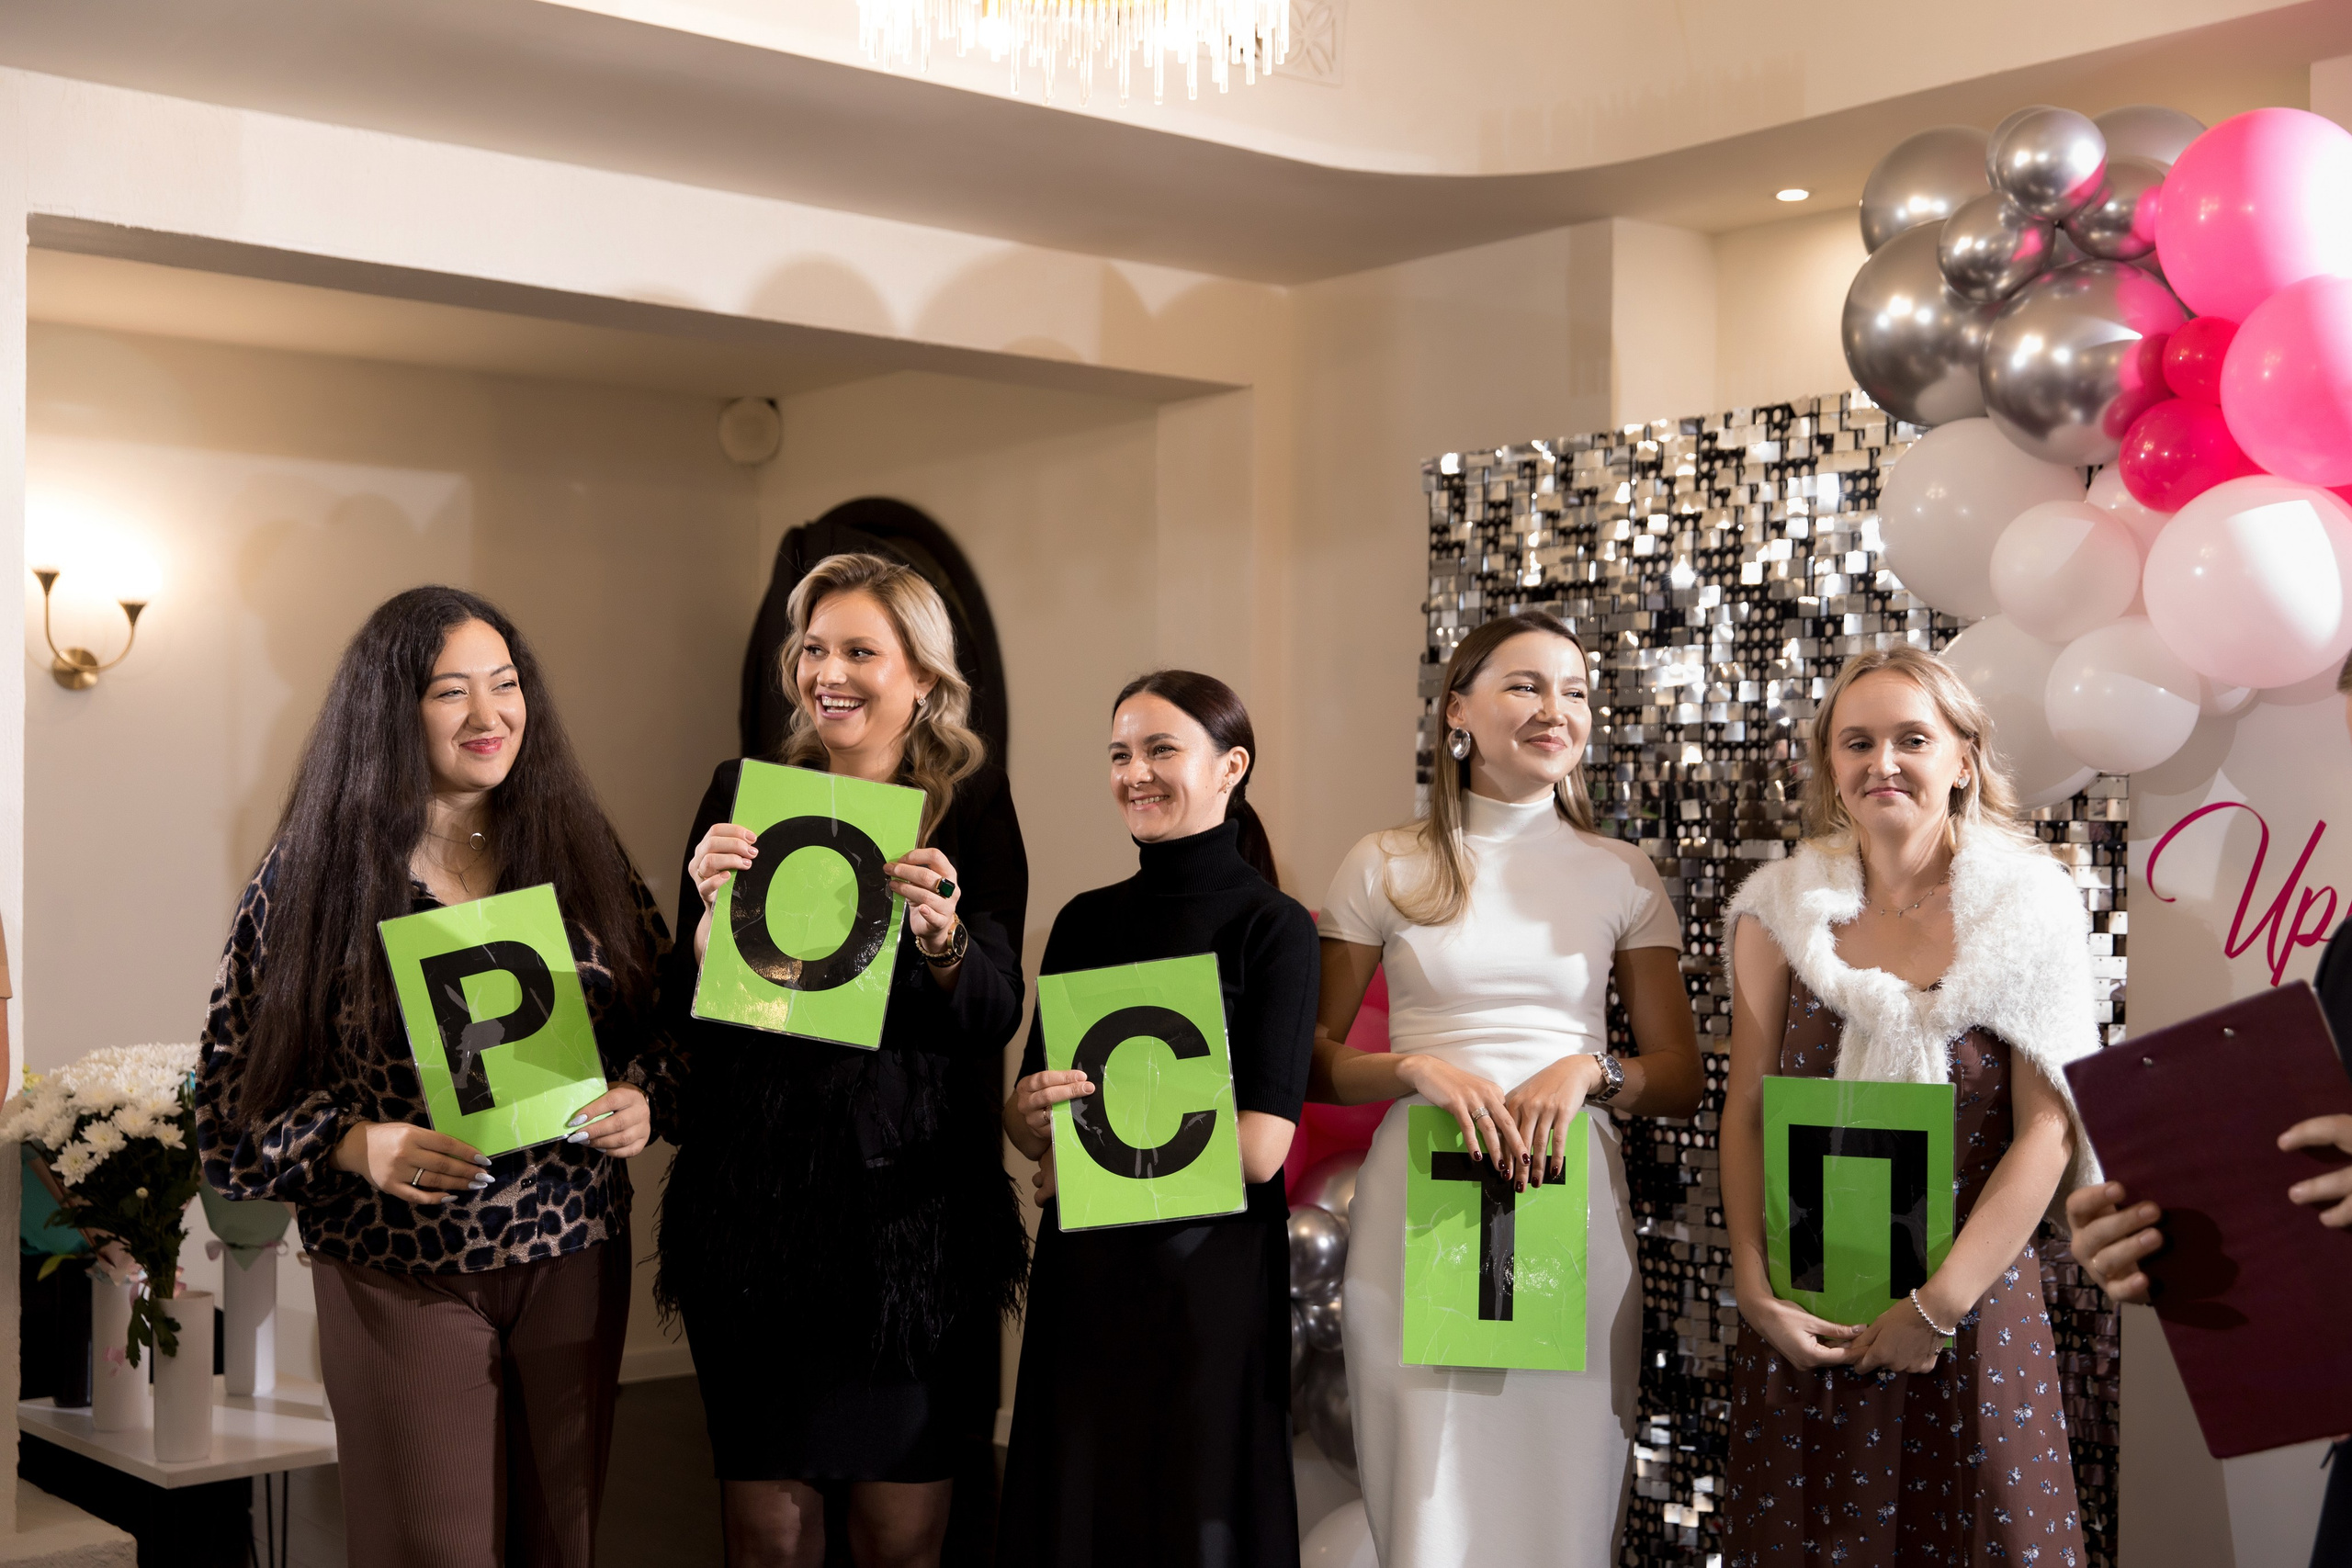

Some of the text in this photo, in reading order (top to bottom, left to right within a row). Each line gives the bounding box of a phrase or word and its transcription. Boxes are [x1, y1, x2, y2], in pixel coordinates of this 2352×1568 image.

[730, 816, 893, 992] О
[2146, 801, 2352, 988] Up
[420, 941, 555, 1116] Р
[1069, 1006, 1217, 1179] С
[1431, 1151, 1566, 1321] Т
[1789, 1123, 1928, 1300] П
